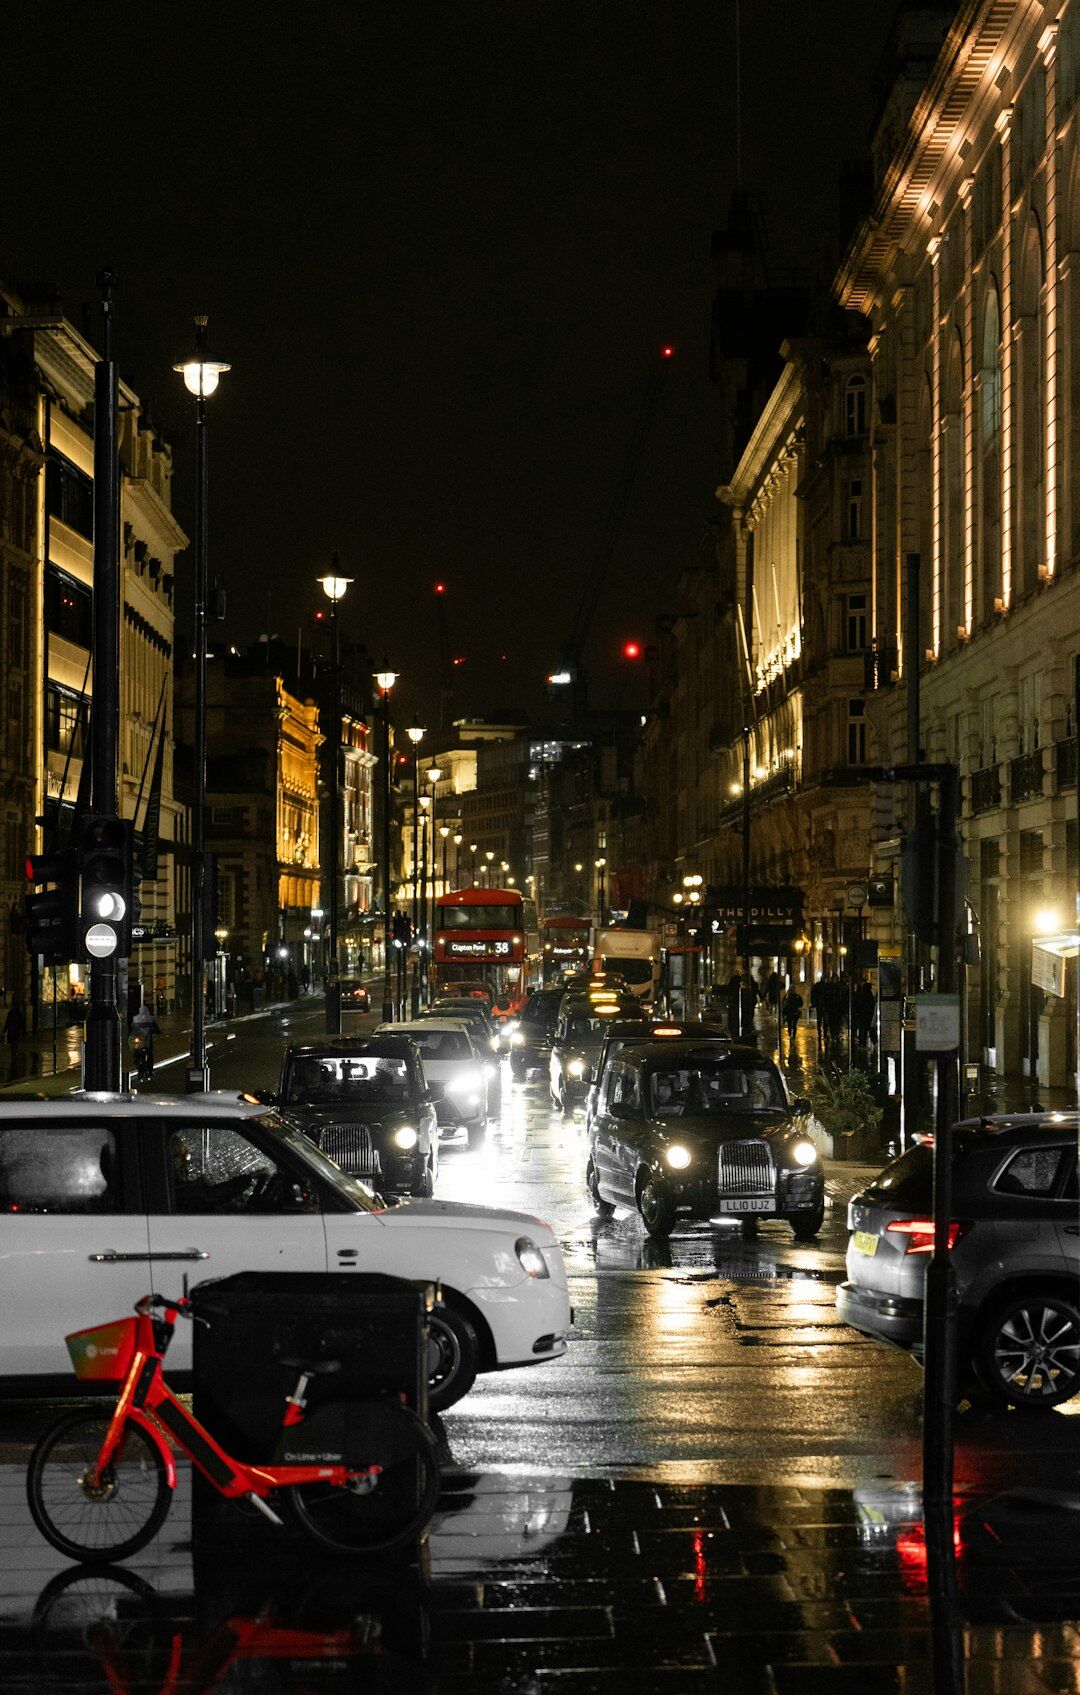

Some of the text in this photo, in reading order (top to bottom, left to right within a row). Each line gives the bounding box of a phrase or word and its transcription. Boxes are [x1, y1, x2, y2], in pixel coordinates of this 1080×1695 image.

[717, 907, 794, 917] THE DILLY
[452, 944, 472, 952] Clapton
[495, 942, 509, 954] 38
[578, 947, 584, 955] 9
[726, 1200, 770, 1211] LL10 UJZ
